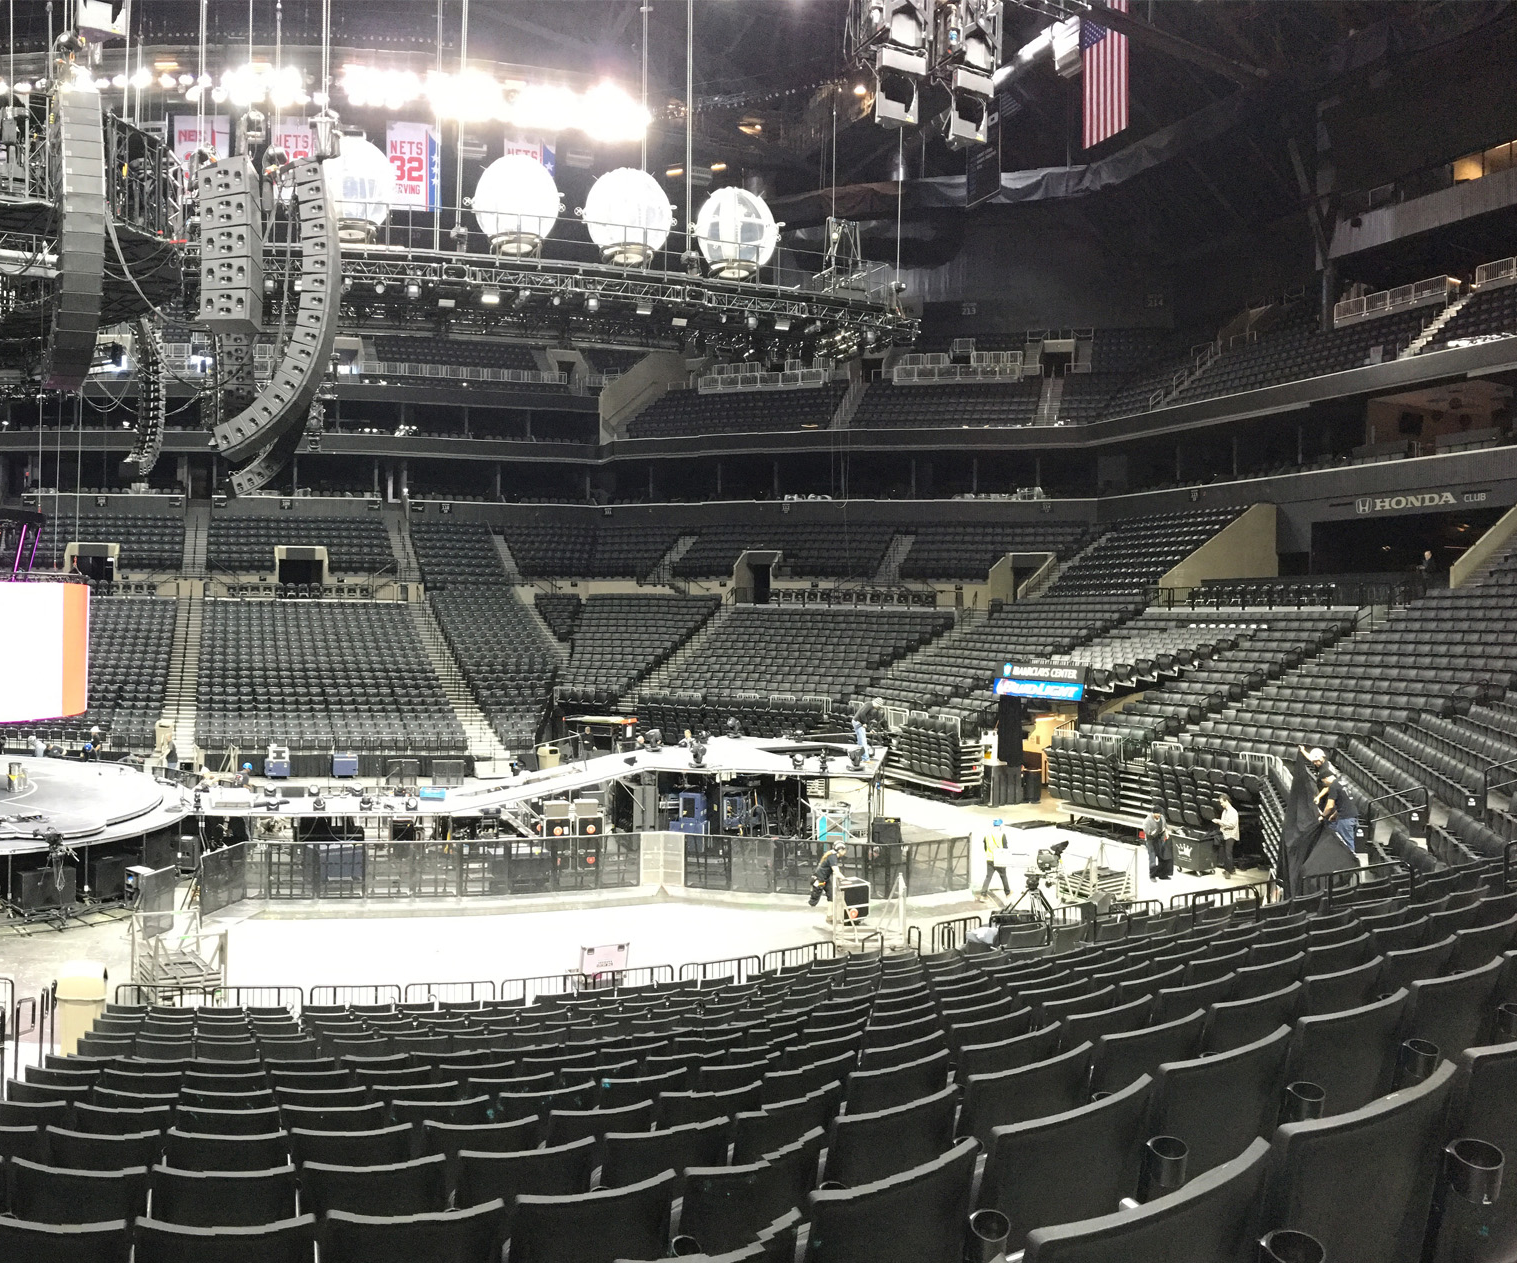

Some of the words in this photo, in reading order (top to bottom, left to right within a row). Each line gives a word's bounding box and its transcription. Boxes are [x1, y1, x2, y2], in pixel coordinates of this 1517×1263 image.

[390, 140, 423, 155] NETS
[389, 155, 423, 182] 32
[1374, 492, 1458, 511] HONDA
[1464, 493, 1487, 503] CLUB
[1012, 666, 1051, 677] BARCLAYS
[1050, 668, 1078, 679] CENTER
[1038, 683, 1079, 698] LIGHT
